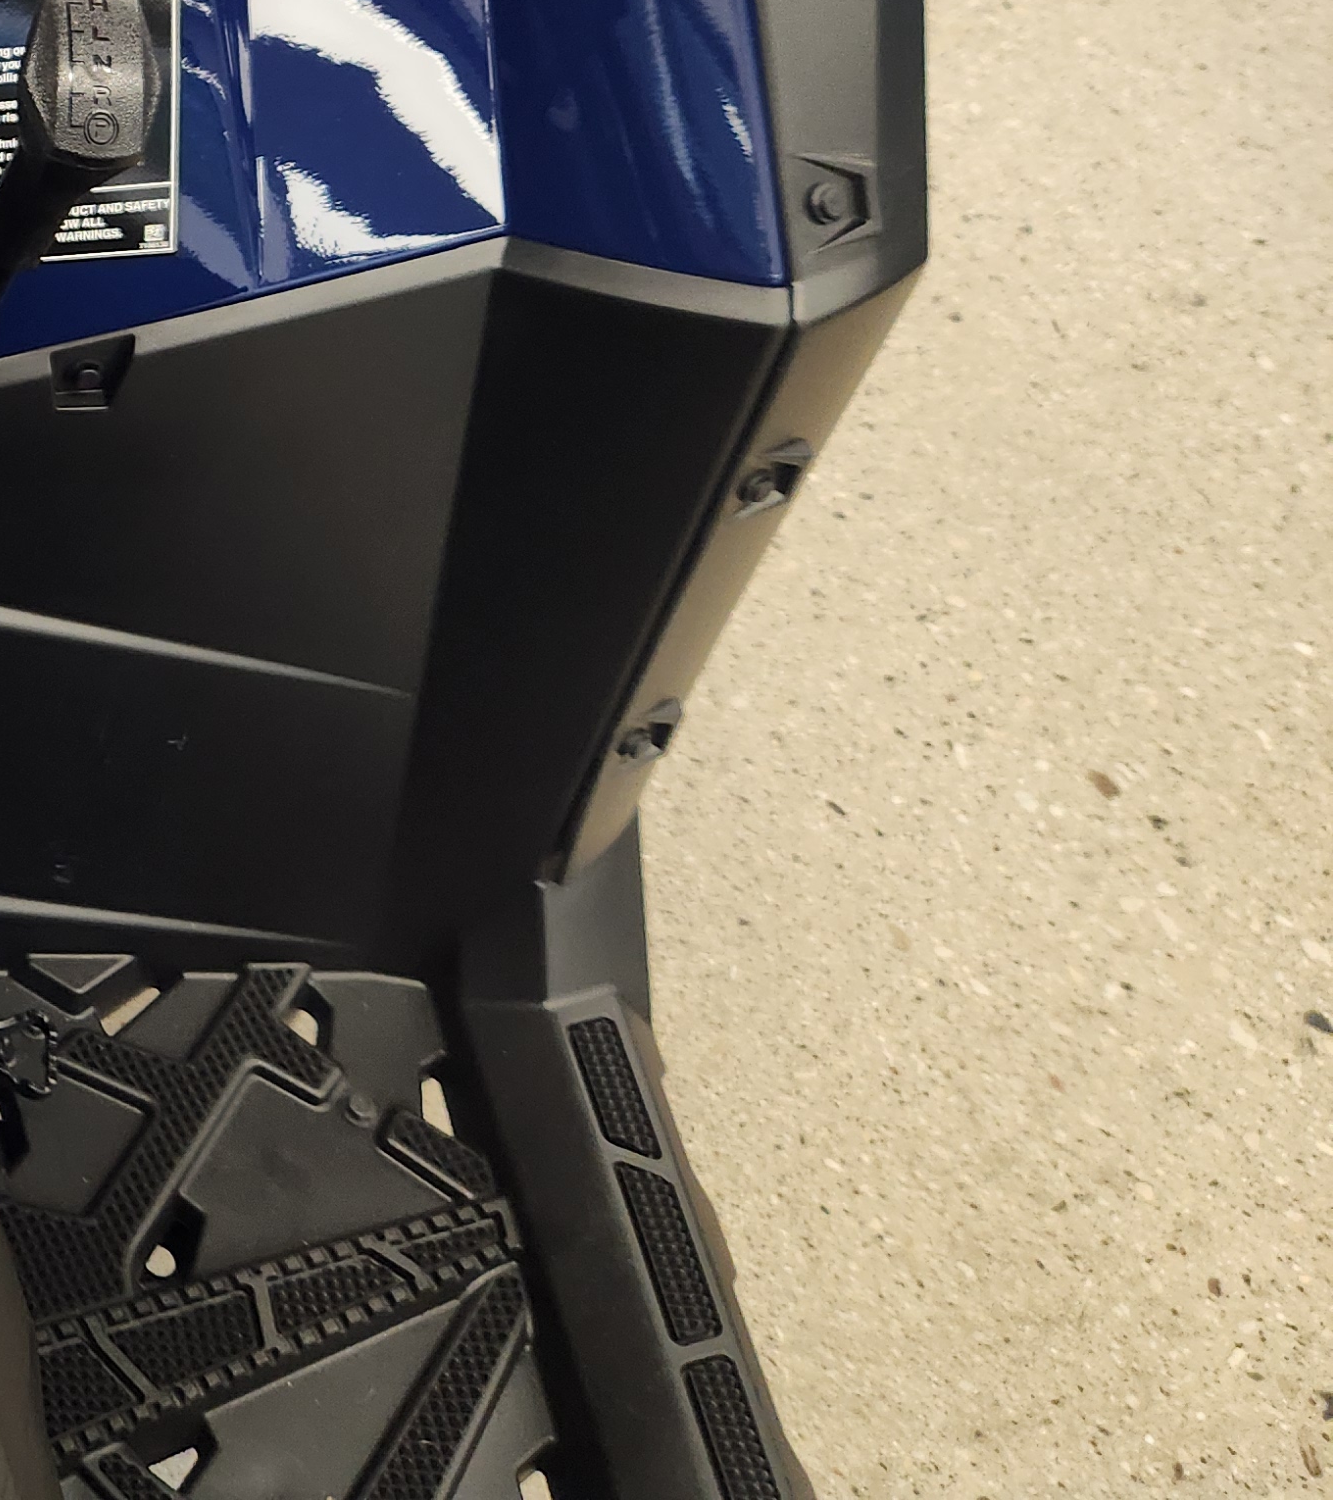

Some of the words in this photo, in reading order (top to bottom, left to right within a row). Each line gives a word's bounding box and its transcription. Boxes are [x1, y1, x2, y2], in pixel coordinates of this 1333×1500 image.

[97, 202, 123, 214] AND
[124, 199, 169, 213] SAFETY
[82, 216, 105, 228] ALL
[54, 228, 123, 242] WARNINGS.
